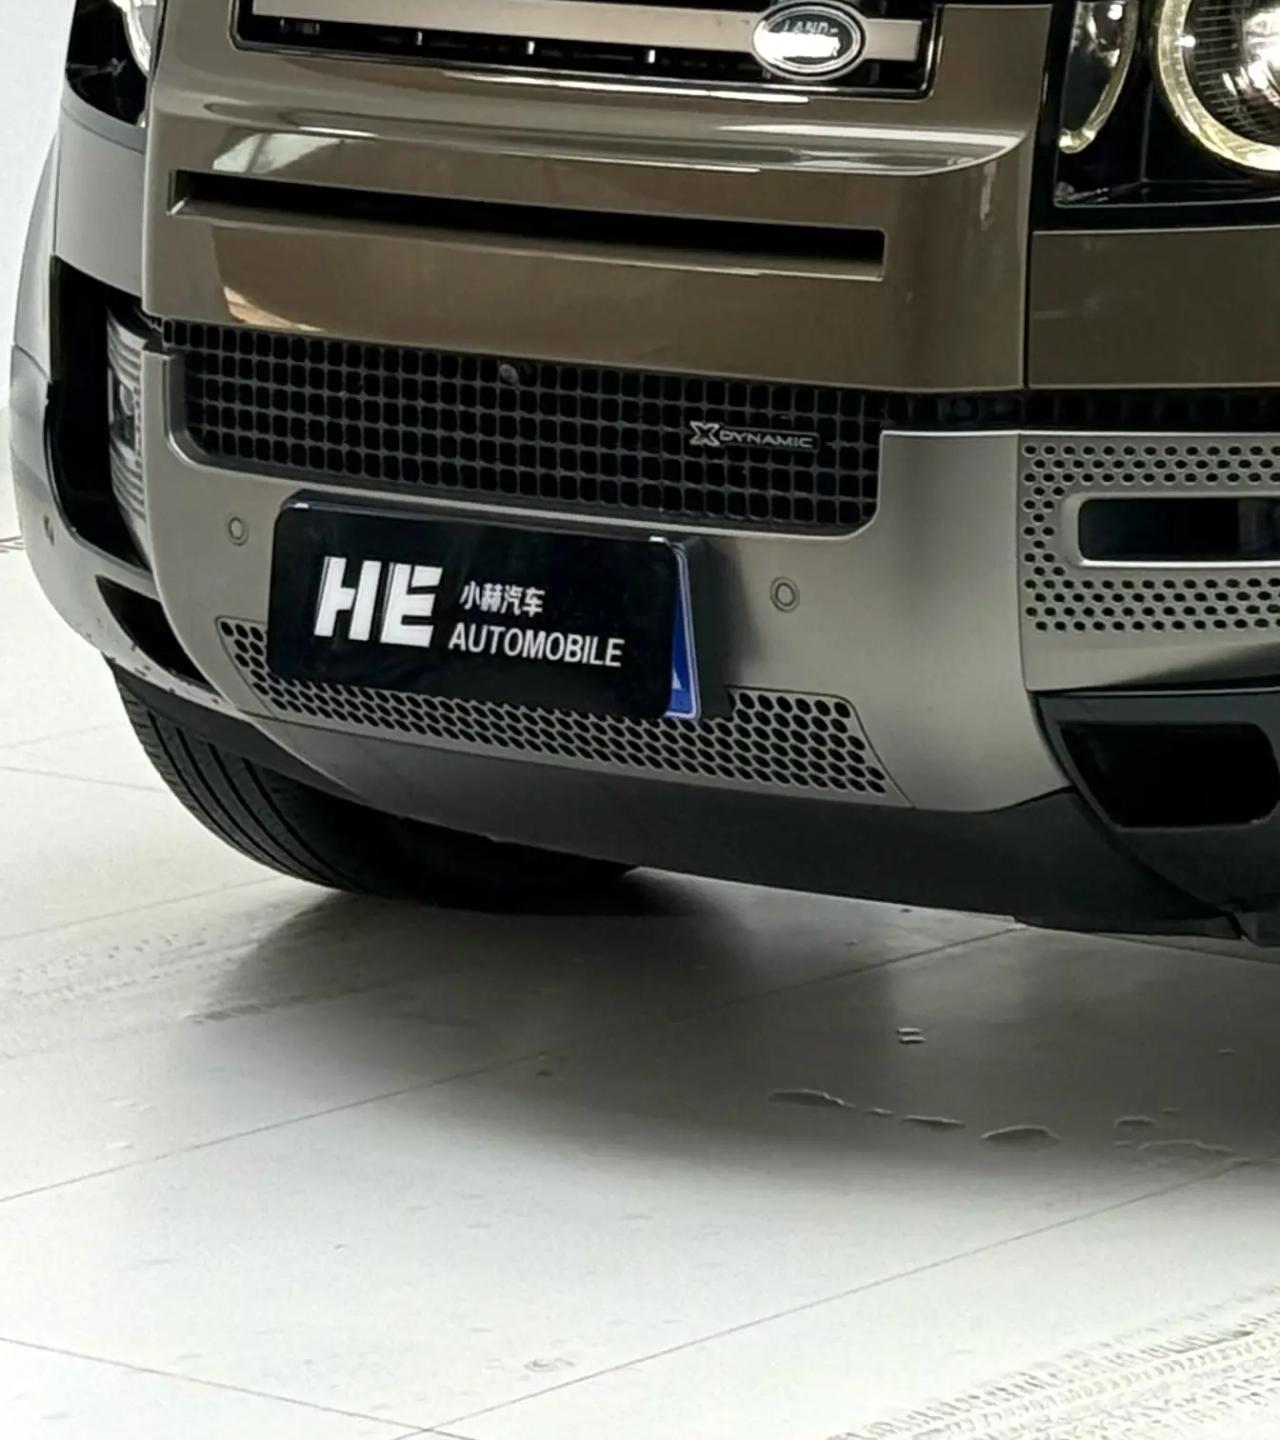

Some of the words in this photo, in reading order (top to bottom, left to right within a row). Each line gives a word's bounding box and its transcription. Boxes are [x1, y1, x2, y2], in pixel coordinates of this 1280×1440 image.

[314, 556, 443, 648] HE
[460, 580, 546, 617] 小赫汽车
[448, 623, 625, 667] AUTOMOBILE
